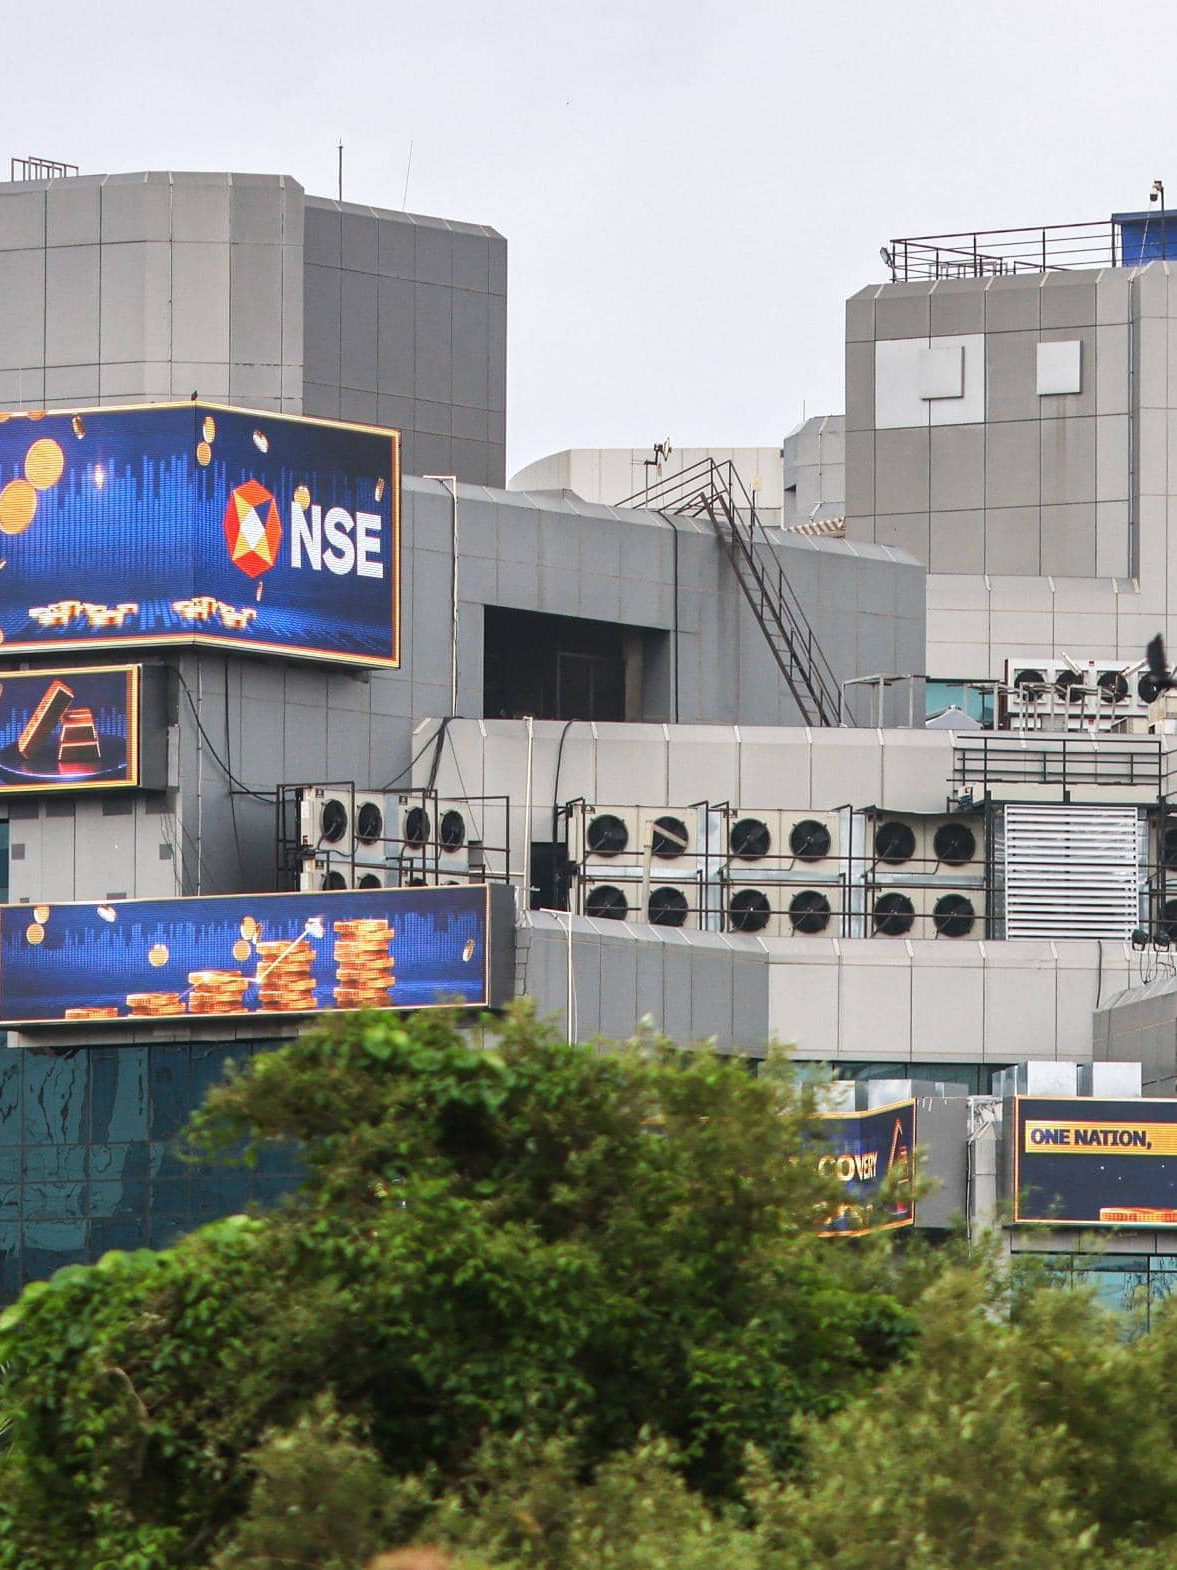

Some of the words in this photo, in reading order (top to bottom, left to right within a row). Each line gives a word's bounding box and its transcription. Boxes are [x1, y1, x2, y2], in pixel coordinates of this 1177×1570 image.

[291, 500, 383, 579] NSE
[1030, 1128, 1071, 1146] ONE
[1074, 1128, 1153, 1150] NATION,
[814, 1151, 878, 1181] COVERY
